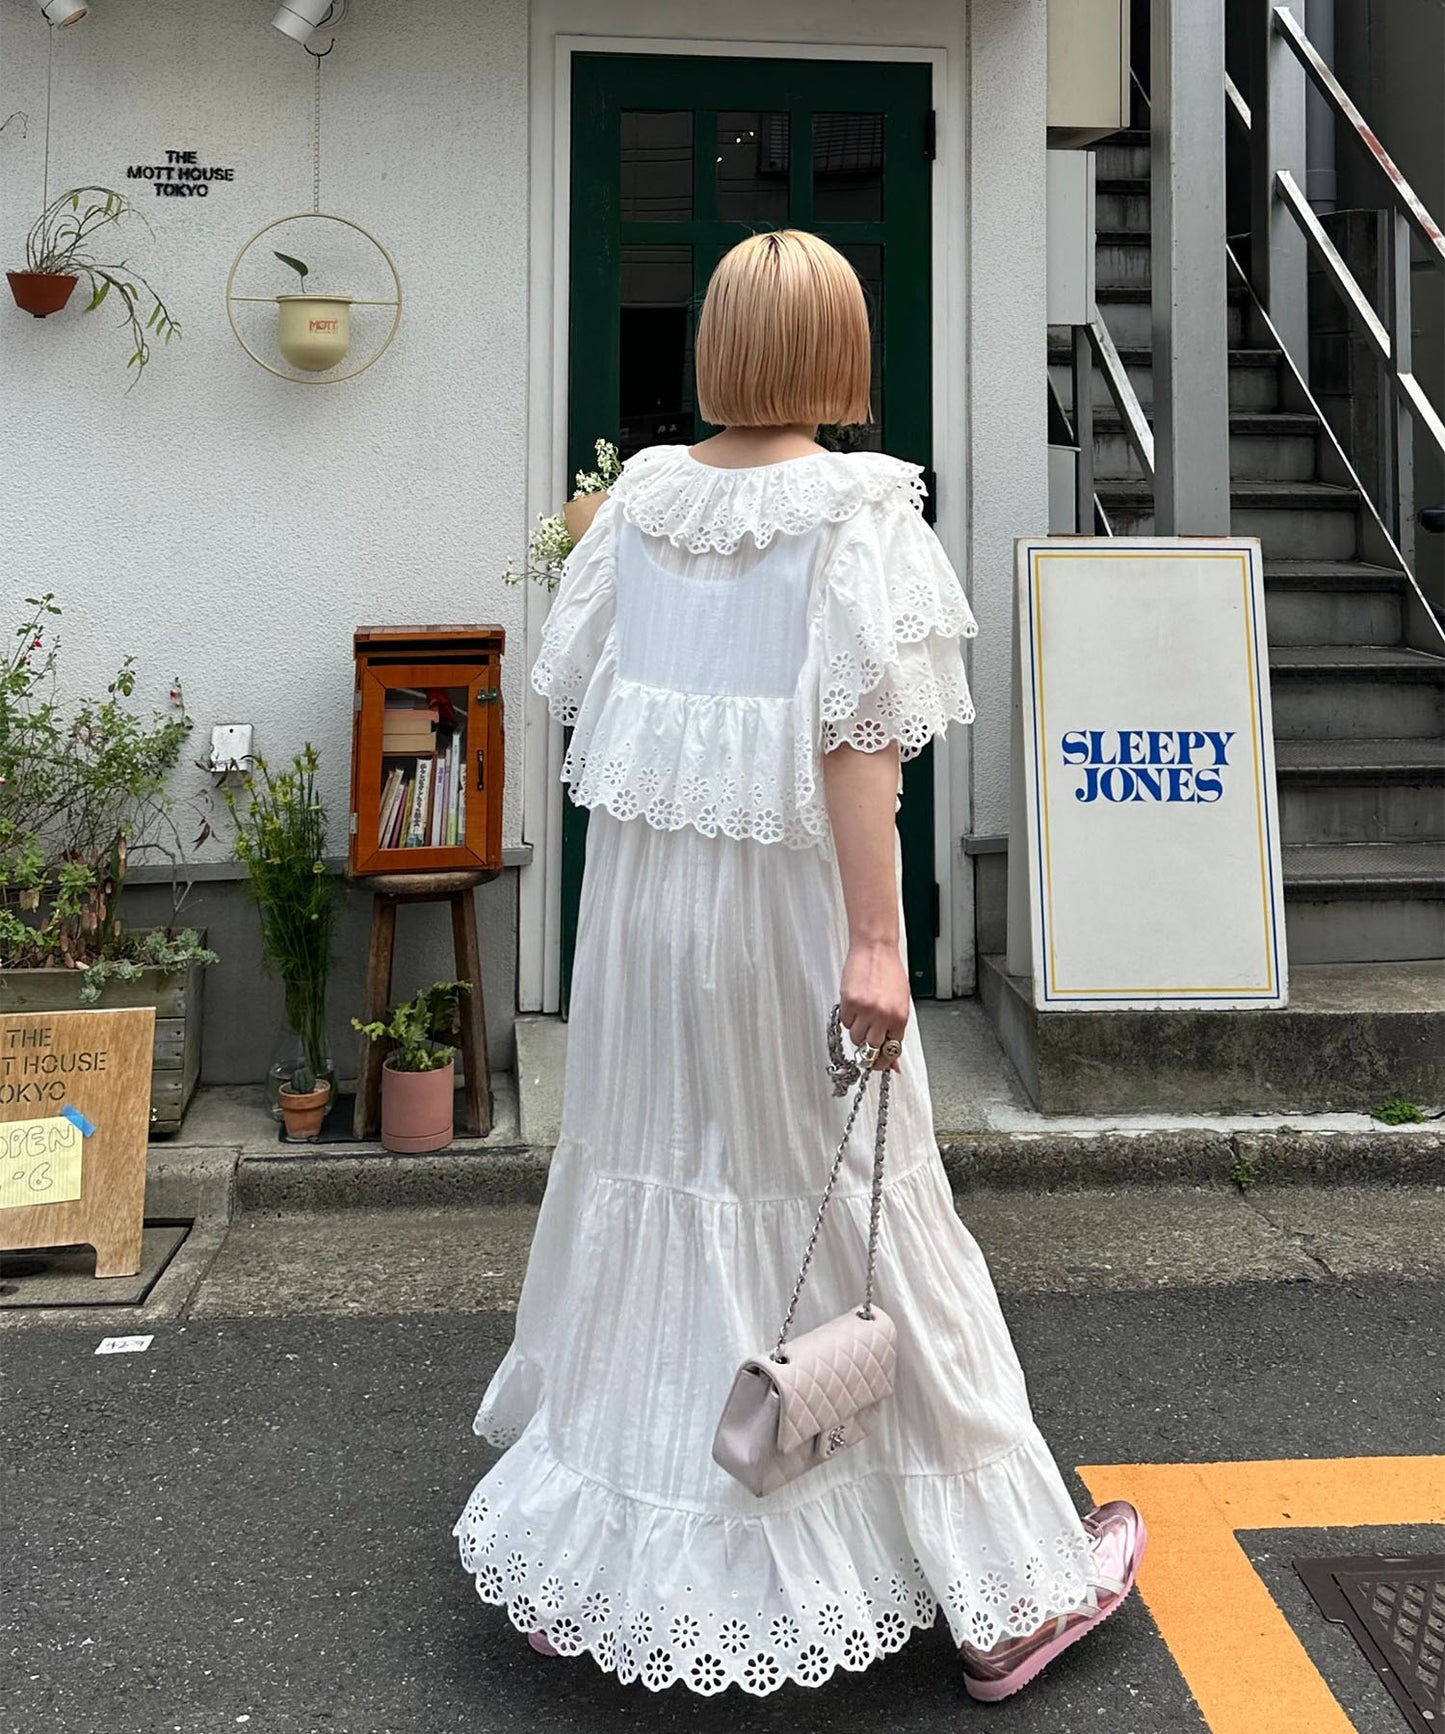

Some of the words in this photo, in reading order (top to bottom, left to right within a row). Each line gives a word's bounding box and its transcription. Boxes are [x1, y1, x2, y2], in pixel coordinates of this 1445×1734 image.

[165, 150, 198, 164] THE
[127, 166, 175, 180] MOTT
[178, 167, 234, 181] HOUSE
[153, 183, 208, 197] TOKYO
[309, 319, 338, 332] MOTT
[1061, 730, 1237, 766] SLEEPY
[1075, 767, 1223, 804] JONES
[6, 1028, 52, 1048] THE
[24, 1052, 107, 1075] HOUSE
